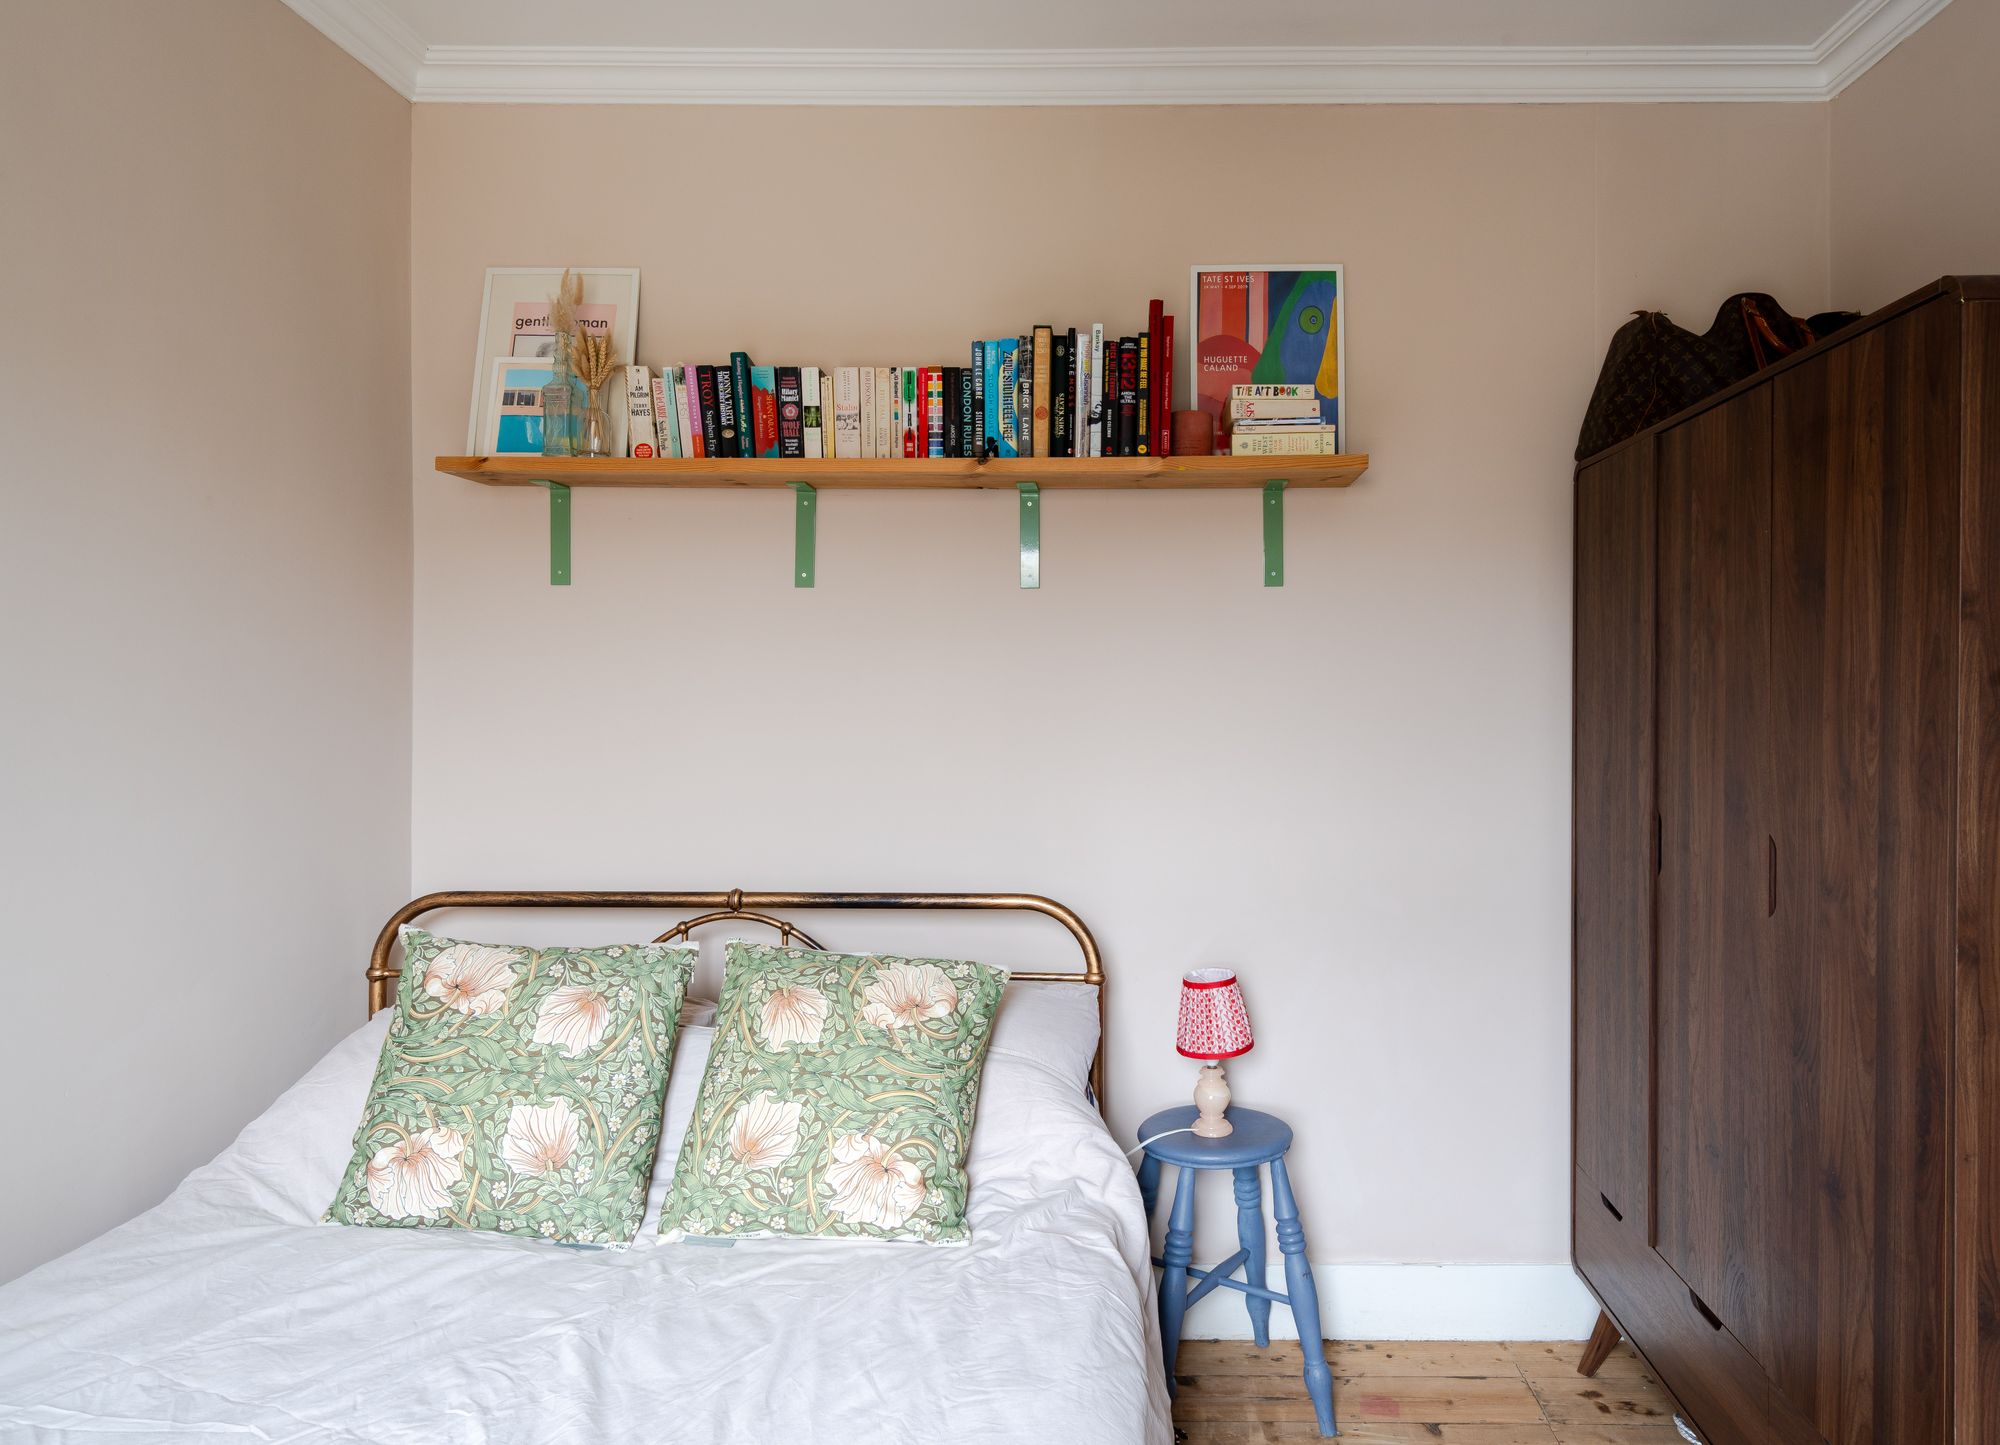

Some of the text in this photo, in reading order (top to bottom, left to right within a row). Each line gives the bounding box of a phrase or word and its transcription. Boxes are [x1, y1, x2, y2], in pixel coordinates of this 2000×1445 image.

[1203, 275, 1255, 283] TATE ST IVES
[515, 316, 608, 330] gentlman
[1203, 355, 1248, 363] HUGUETTE
[1121, 353, 1136, 390] 1312
[1203, 364, 1238, 372] CALAND
[781, 388, 798, 396] Hilary
[1003, 351, 1014, 441] ZADIE SMITH FEEL FREE
[1235, 386, 1252, 396] THE
[1273, 386, 1299, 396] BOOK
[723, 371, 734, 426] DONNA TARTT
[963, 376, 972, 422] LONDON
[701, 371, 717, 452] TROY Stephen Fry
[836, 403, 858, 411] Stalin
[766, 395, 775, 439] SHANTARAM
[782, 421, 800, 429] WOLF
[975, 411, 983, 446] SILVERVIEW
[783, 429, 800, 437] HALL
[660, 437, 668, 451] People
[950, 438, 956, 446] OZ
[963, 425, 972, 456] RULES
